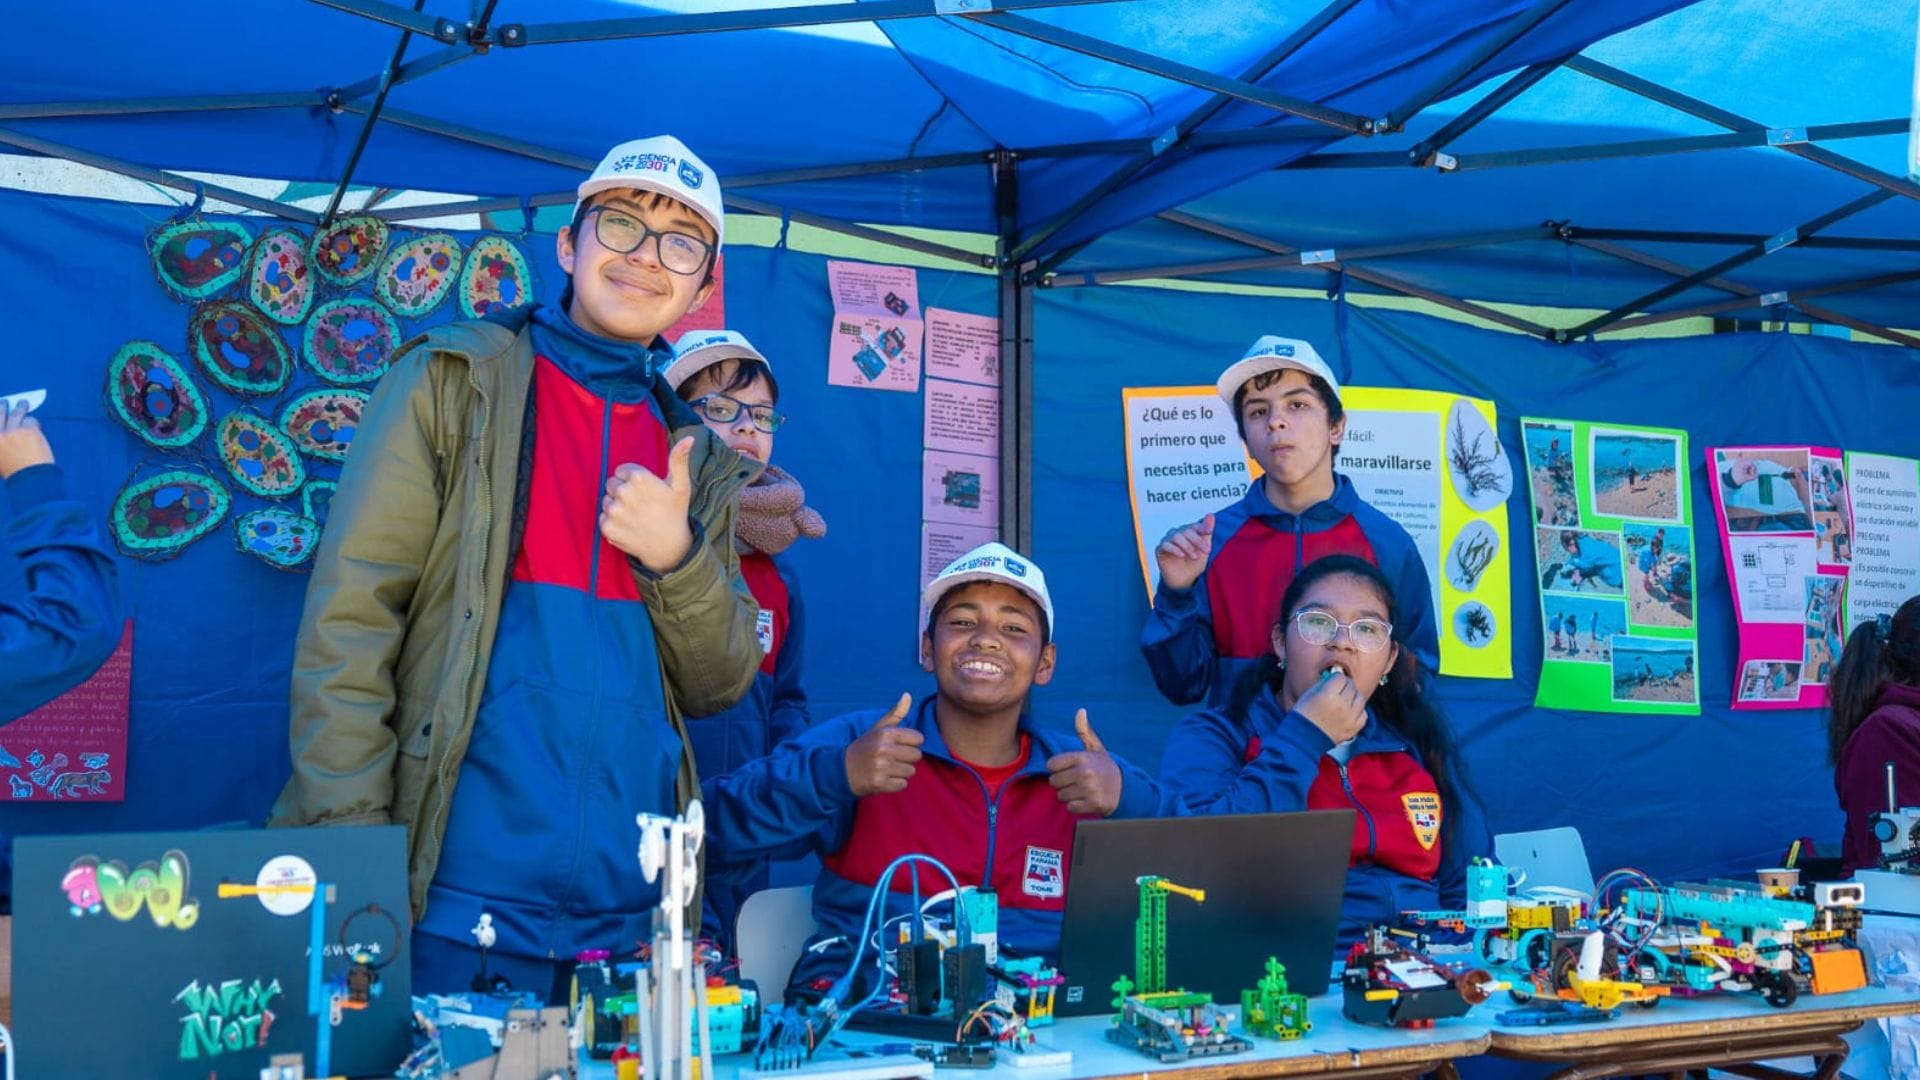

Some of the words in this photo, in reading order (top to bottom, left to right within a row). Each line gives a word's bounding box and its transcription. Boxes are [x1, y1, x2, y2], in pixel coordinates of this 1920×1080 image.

[635, 160, 662, 171] 2030
[638, 153, 676, 166] CIENCIA
[1142, 407, 1179, 422] ¿Qué
[1182, 409, 1197, 420] es
[1201, 406, 1214, 419] lo
[1140, 433, 1196, 450] primero
[1200, 434, 1226, 448] que
[1144, 462, 1209, 477] necesitas
[1213, 461, 1246, 475] para
[1341, 455, 1432, 470] maravillarse
[1856, 469, 1890, 480] PROBLEMA
[1146, 489, 1187, 502] hacer
[1191, 483, 1248, 500] ciencia?
[1856, 485, 1875, 495] Cortes
[1877, 487, 1885, 496] de
[1856, 531, 1890, 542] PREGUNTA
[1856, 546, 1890, 557] PROBLEMA
[172, 978, 282, 1019] WHY
